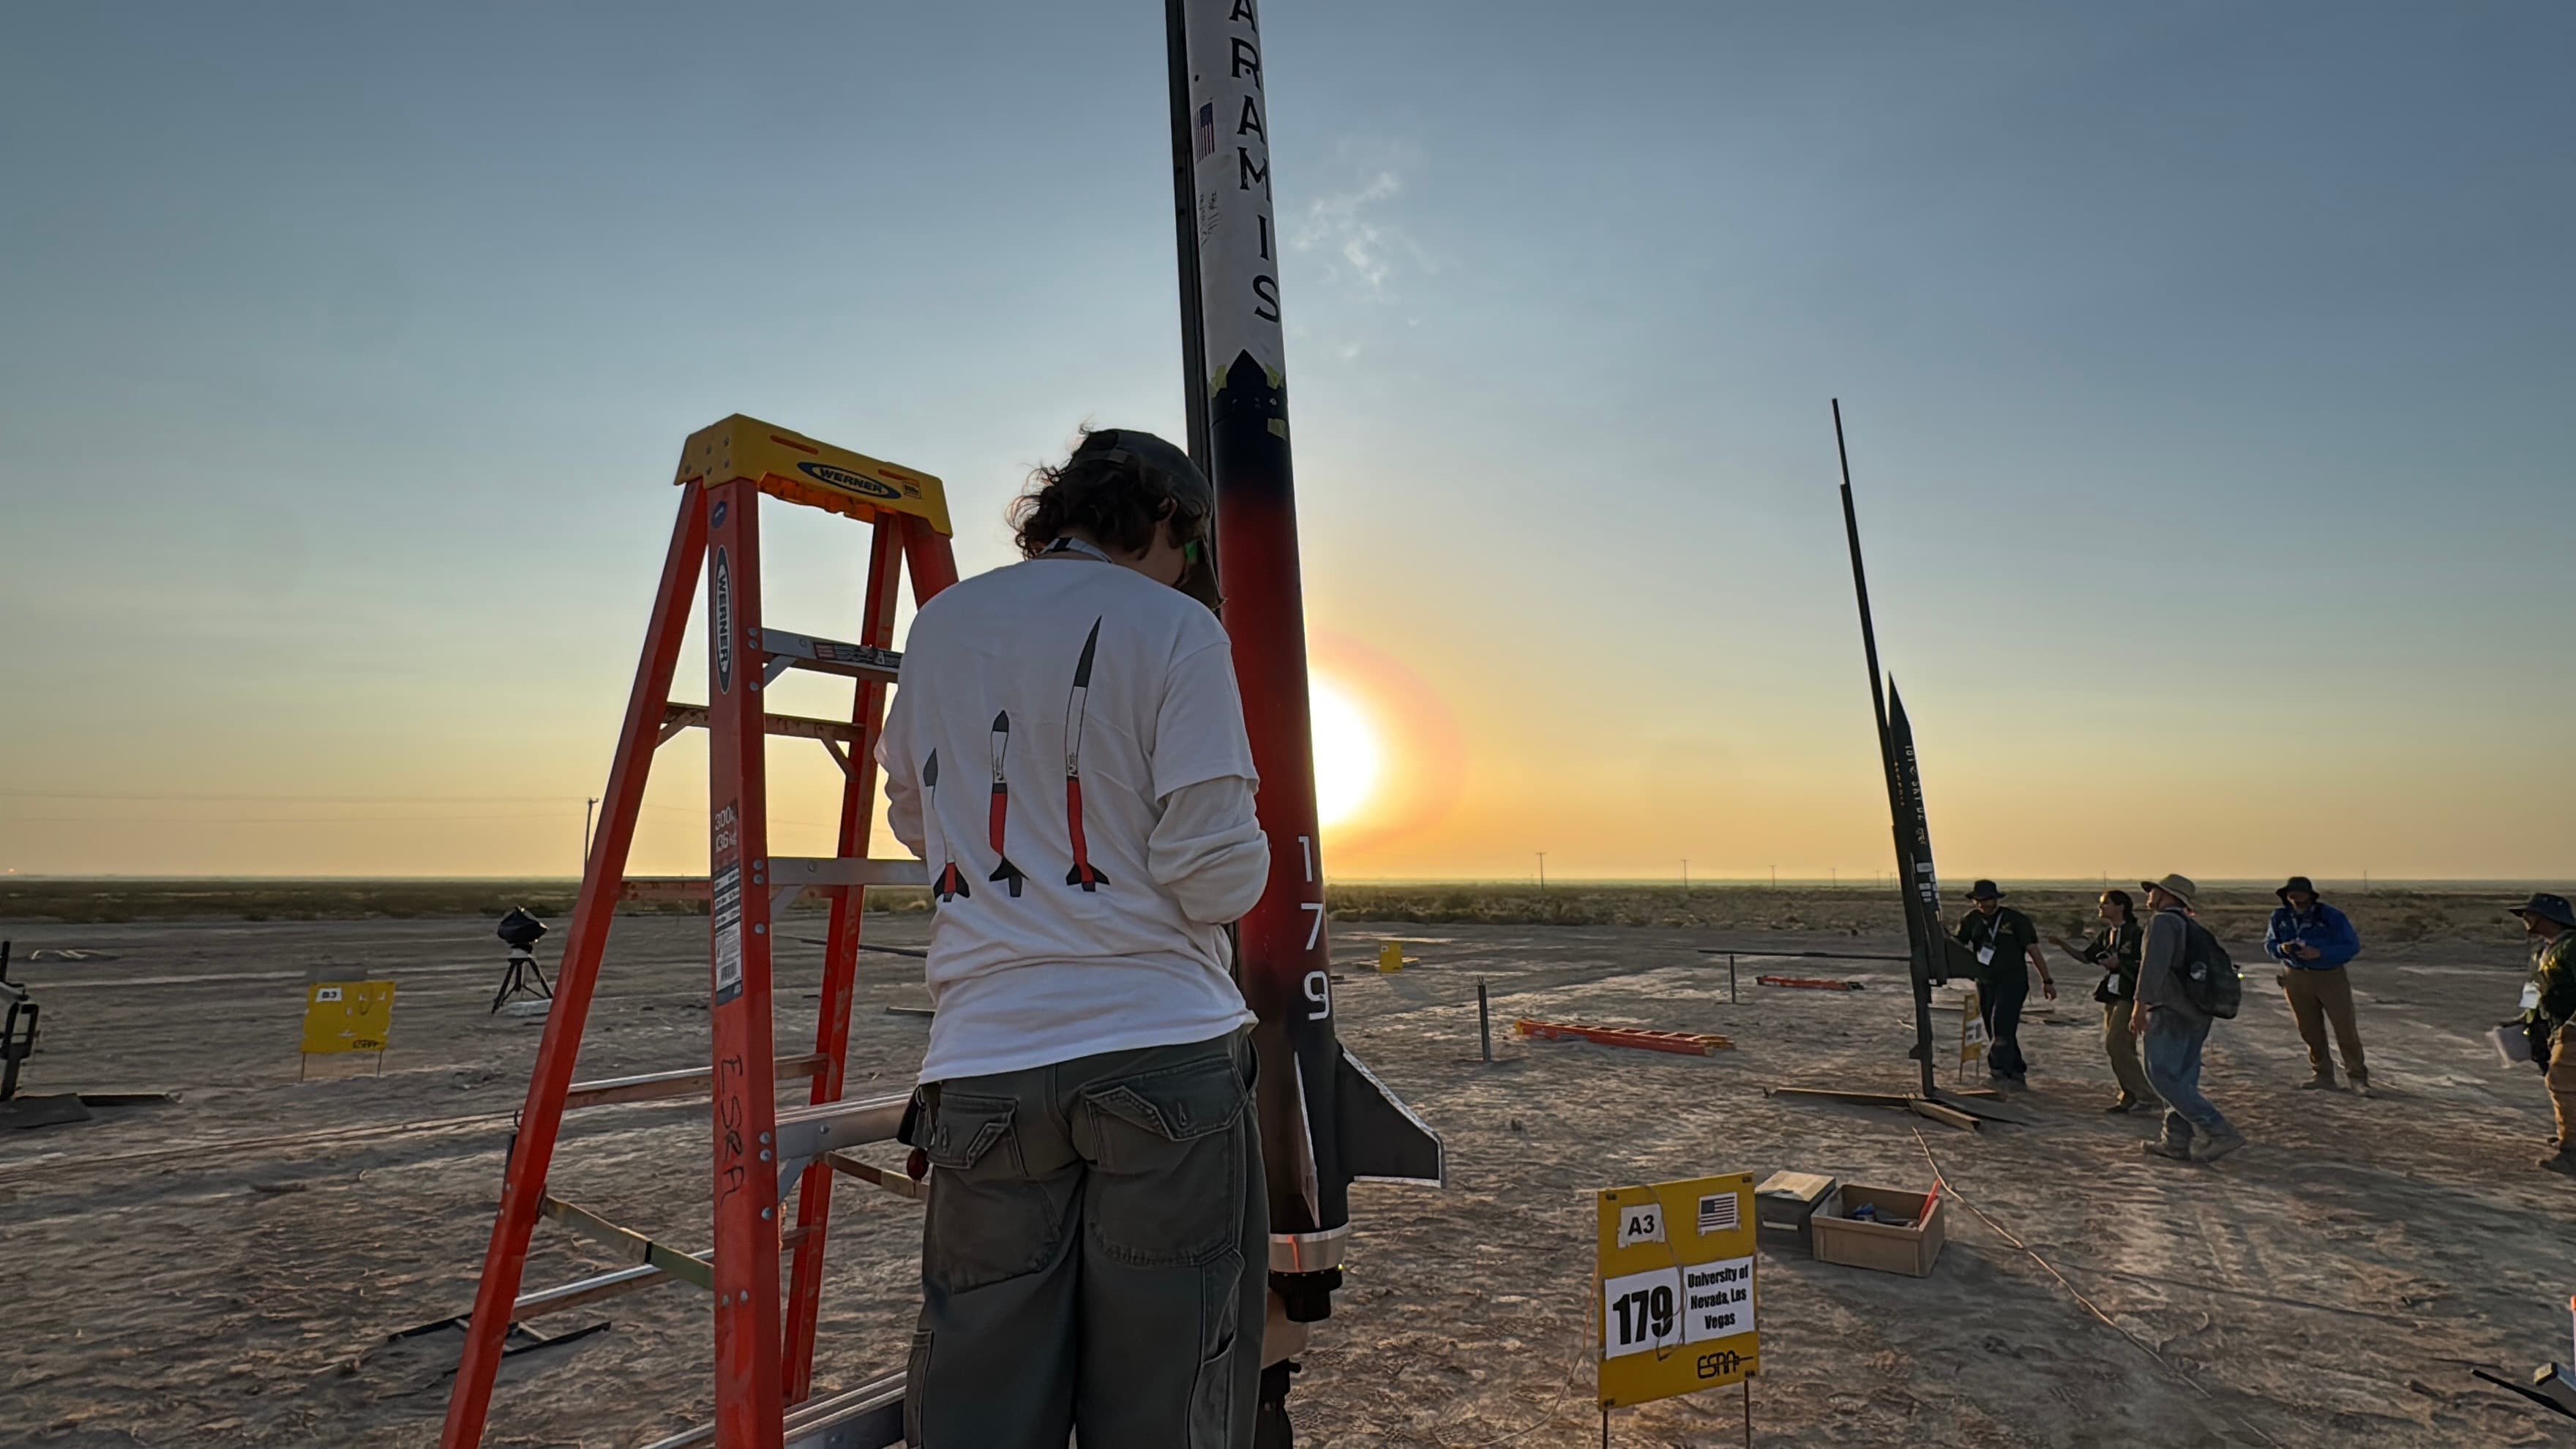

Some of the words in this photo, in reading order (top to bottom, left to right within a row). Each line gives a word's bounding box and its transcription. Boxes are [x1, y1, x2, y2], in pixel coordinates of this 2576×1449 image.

[820, 468, 883, 494] WERNER
[719, 574, 729, 665] WERNER
[1298, 836, 1330, 1021] 179
[720, 1055, 745, 1208] ESRA
[1628, 1215, 1655, 1236] A3
[1688, 1266, 1737, 1288] University
[1739, 1265, 1749, 1281] of
[1690, 1291, 1729, 1310] Nevada,
[1731, 1287, 1746, 1303] Las
[1612, 1285, 1674, 1345] 179
[1704, 1311, 1736, 1330] Vegas
